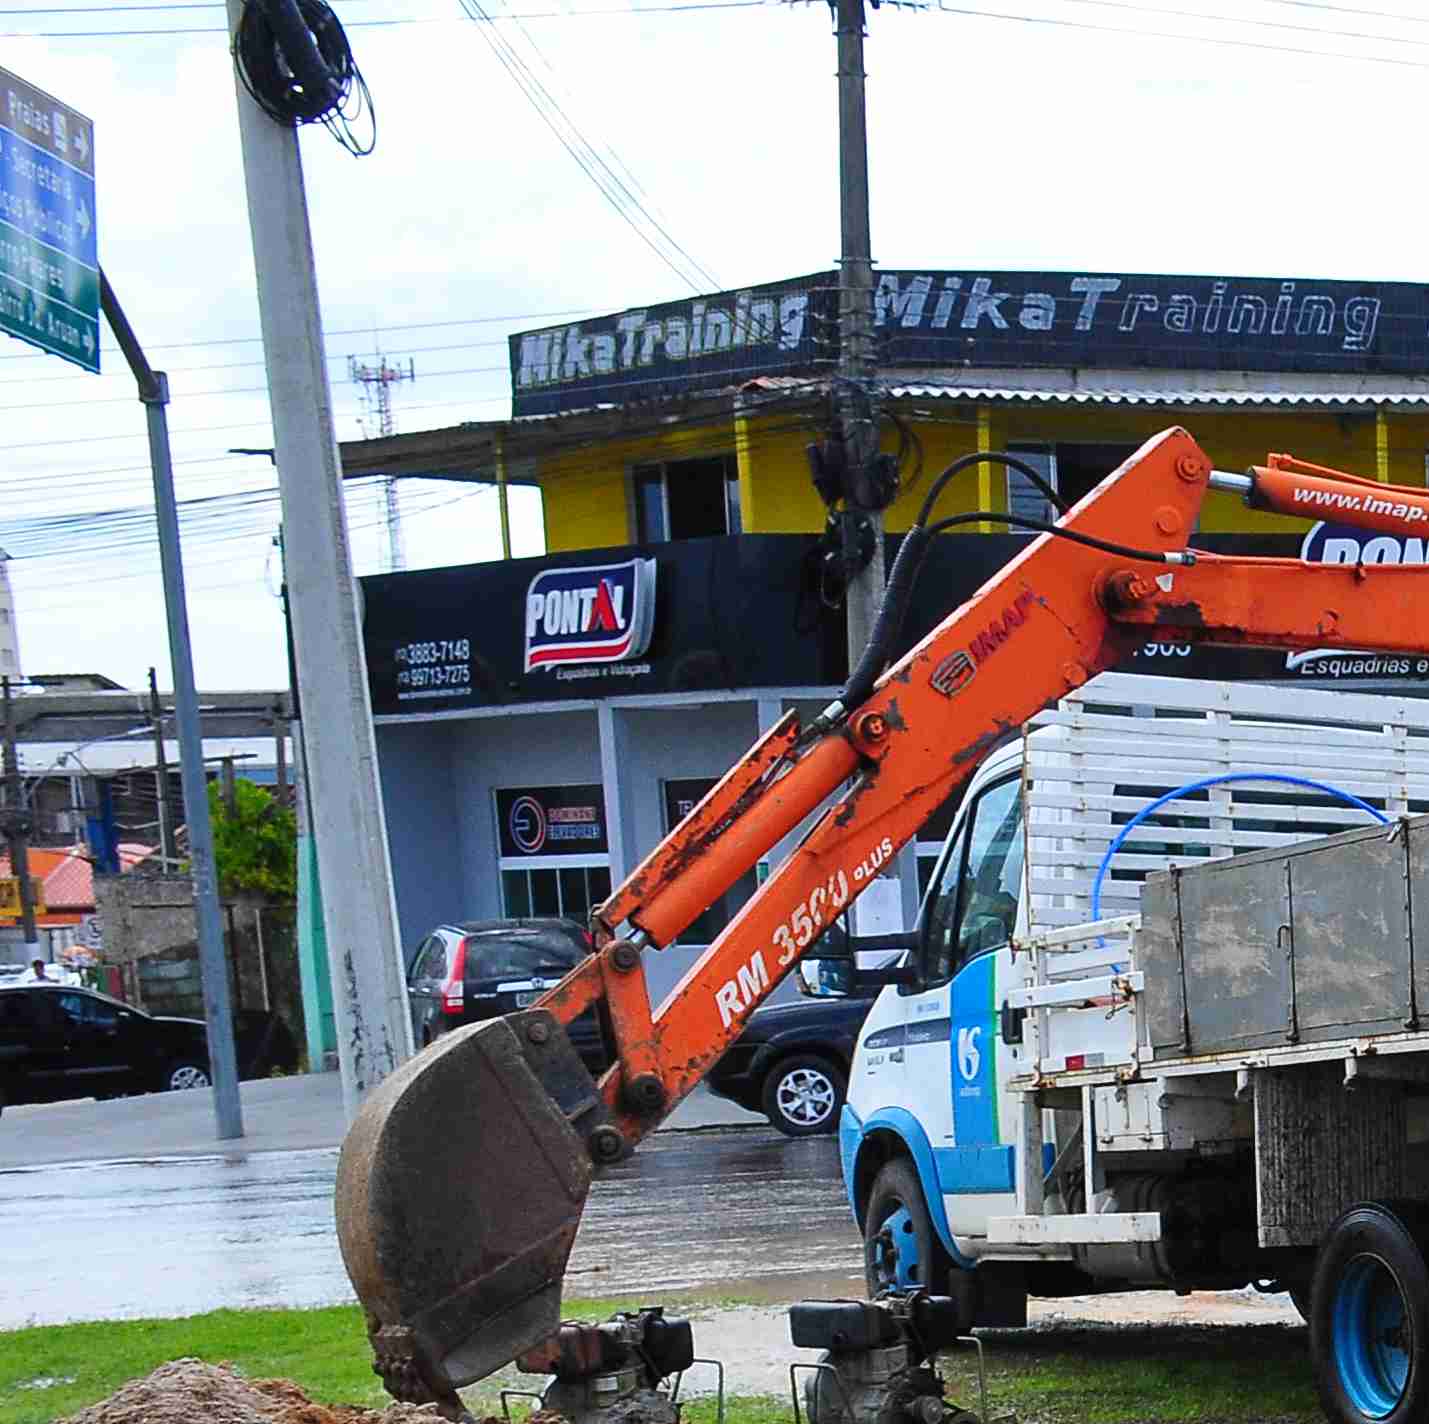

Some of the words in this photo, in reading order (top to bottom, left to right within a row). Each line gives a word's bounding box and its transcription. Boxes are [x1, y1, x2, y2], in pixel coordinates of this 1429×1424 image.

[8, 87, 50, 136] Praias
[518, 290, 809, 388] MikaTraining
[872, 273, 1382, 351] MikaTraining
[527, 578, 626, 639] PONTAL
[1301, 655, 1410, 678] Esquadrias
[1416, 659, 1429, 674] e
[714, 950, 770, 1029] RM
